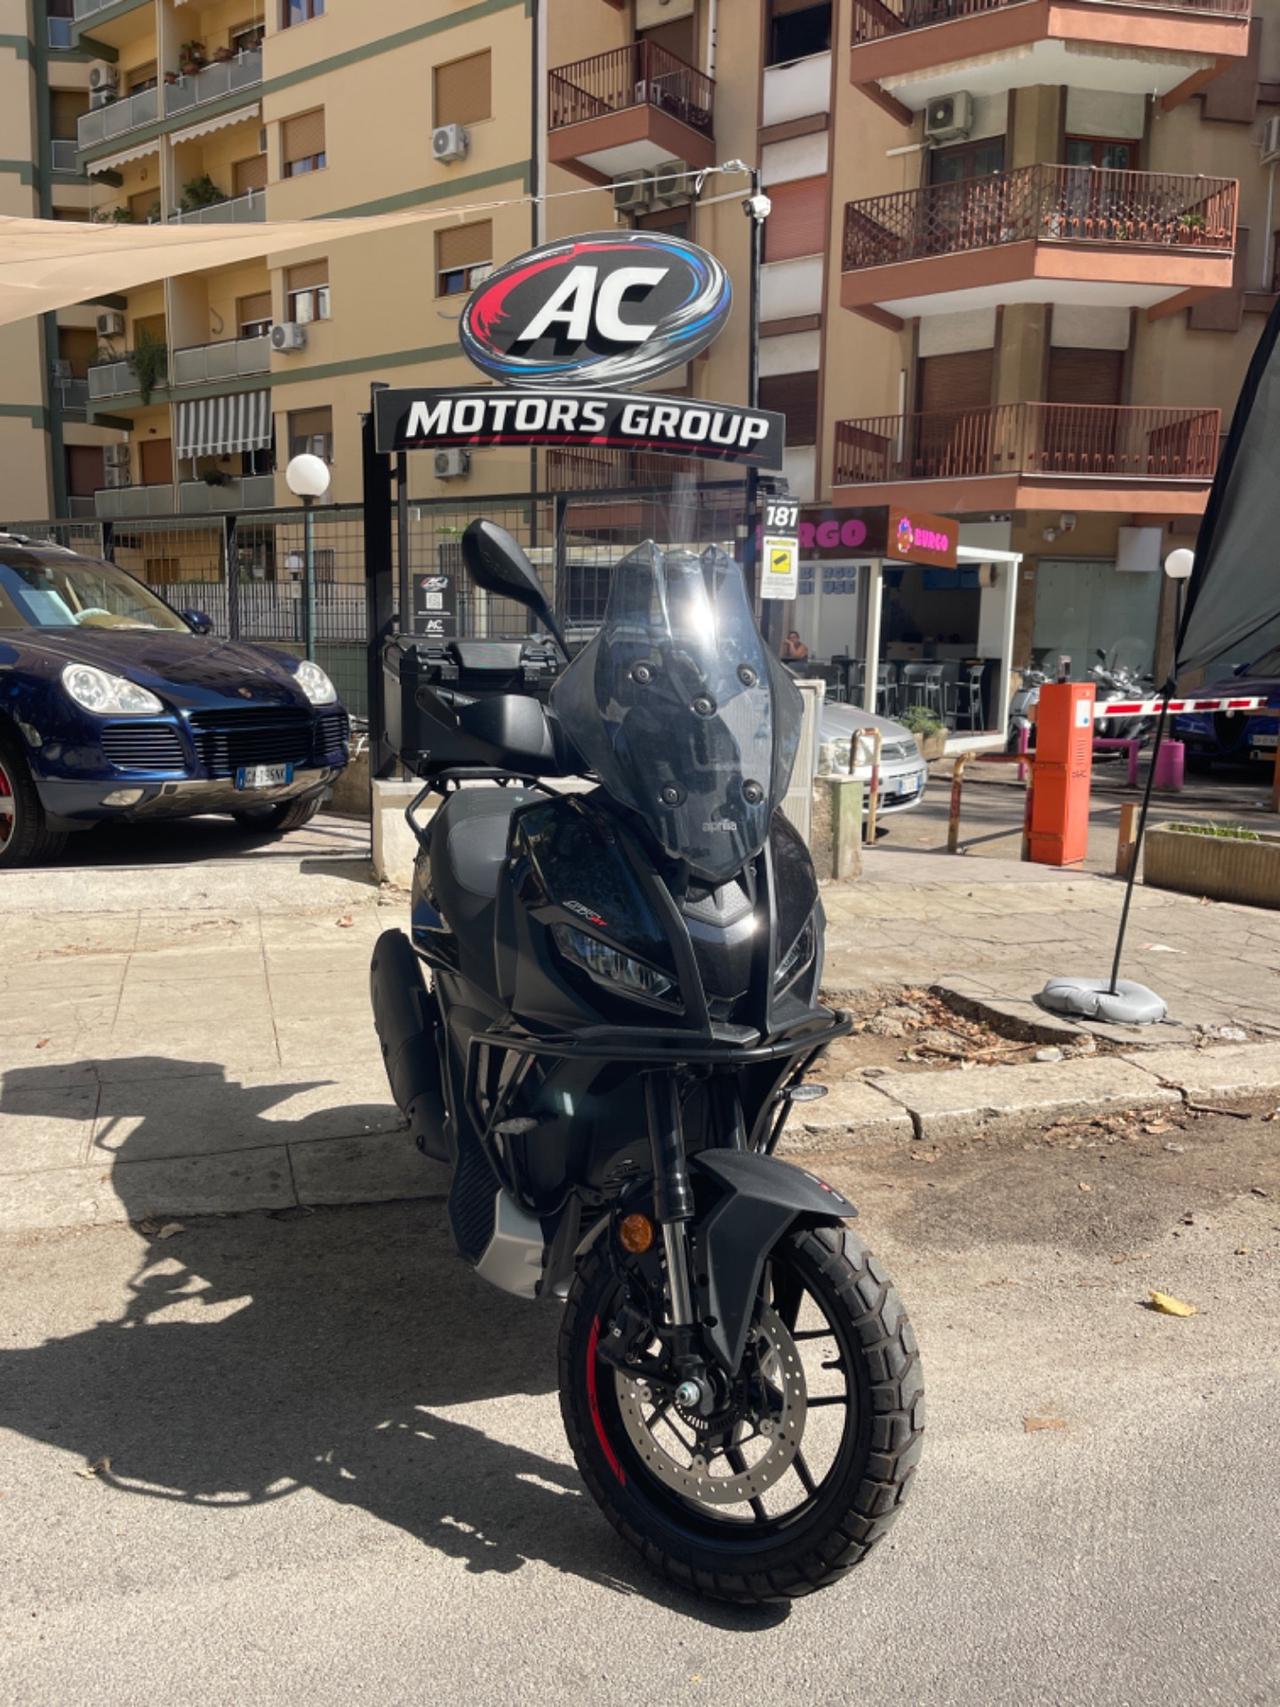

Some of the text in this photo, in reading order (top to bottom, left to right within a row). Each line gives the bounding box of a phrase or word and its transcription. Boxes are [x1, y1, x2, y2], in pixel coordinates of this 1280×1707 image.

[516, 265, 670, 342] AC
[405, 398, 770, 448] MOTORS GROUP
[766, 505, 798, 528] 181
[914, 527, 949, 552] BURGO
[427, 619, 443, 629] AC
